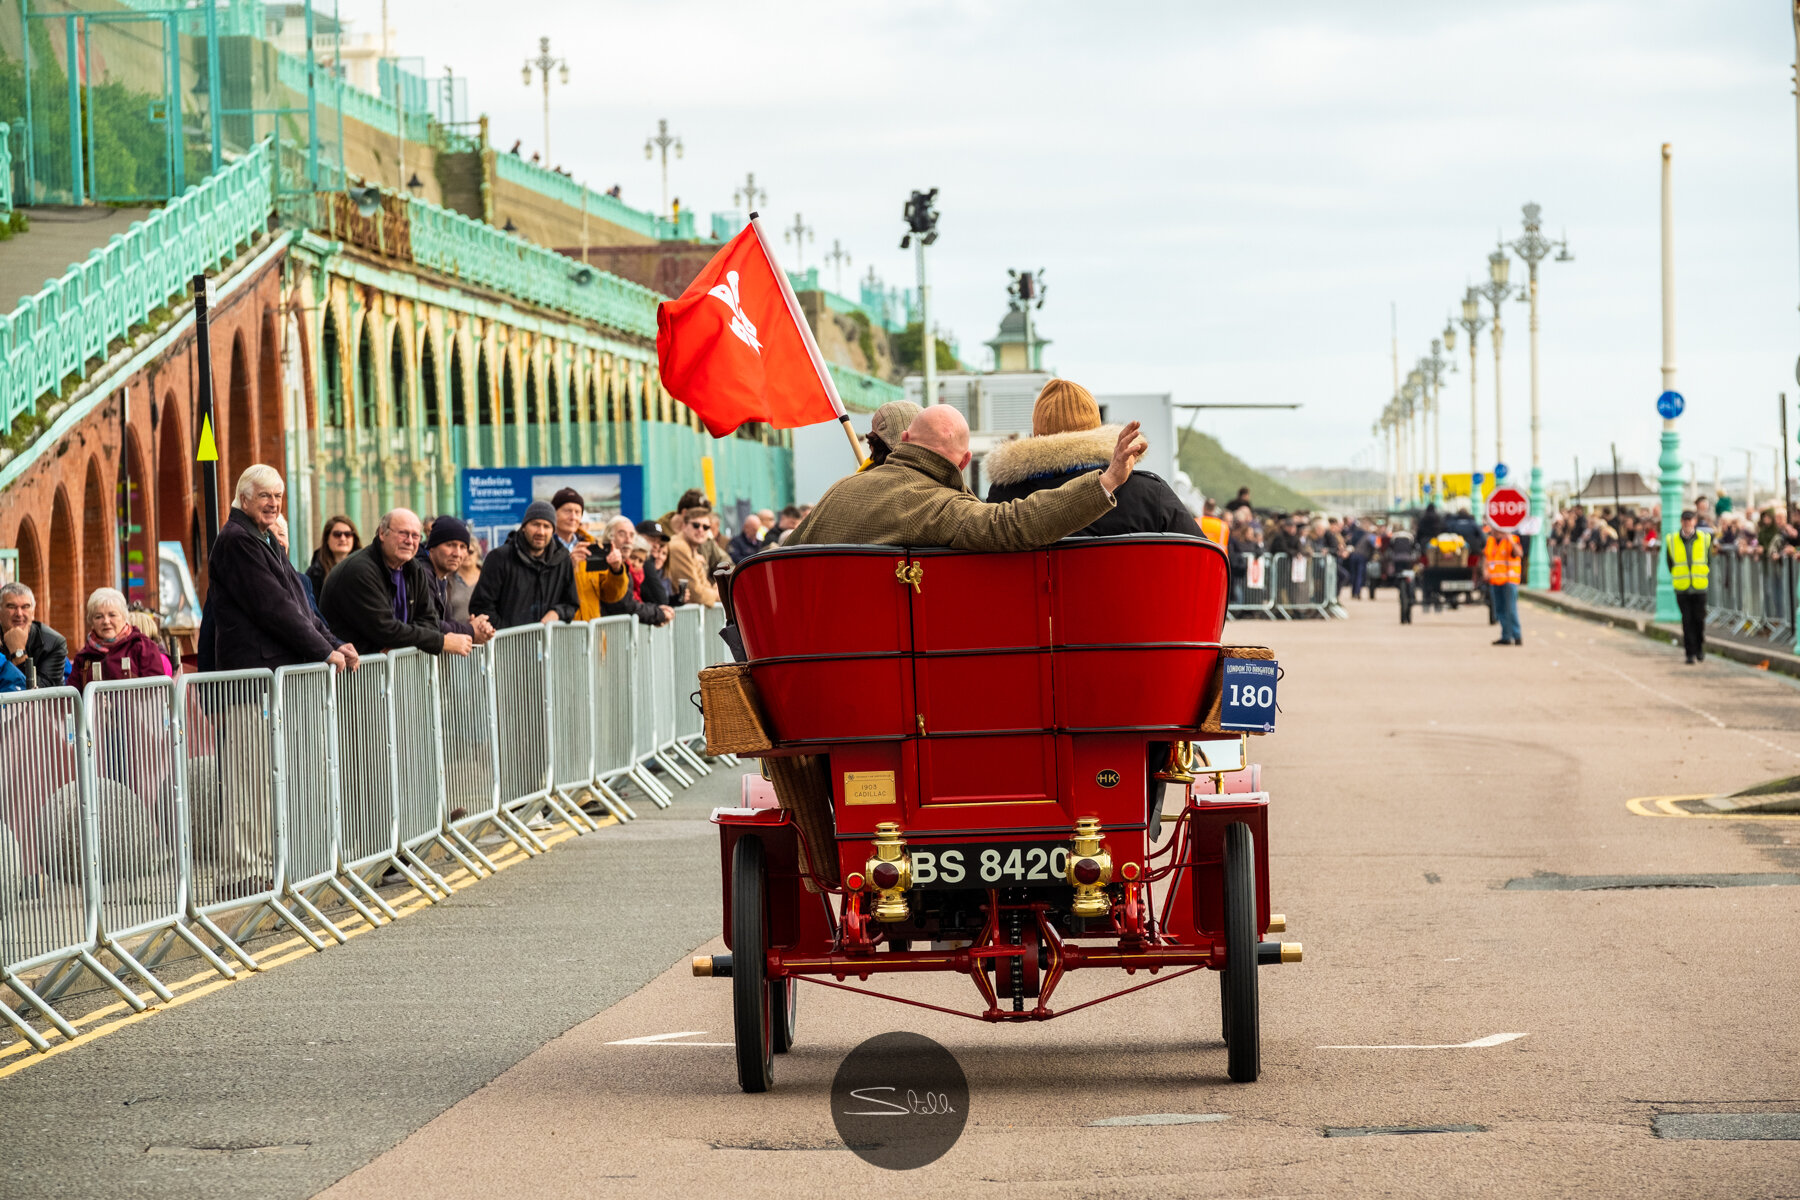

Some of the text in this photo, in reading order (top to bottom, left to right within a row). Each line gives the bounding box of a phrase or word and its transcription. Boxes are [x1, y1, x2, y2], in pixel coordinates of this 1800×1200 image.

[1489, 501, 1526, 516] STOP
[1226, 665, 1245, 674] LONDON
[1246, 665, 1252, 673] TO
[1252, 666, 1275, 676] BRIGHTON
[1229, 684, 1273, 708] 180
[1099, 773, 1117, 783] HK
[911, 847, 1069, 884] BS 8420
